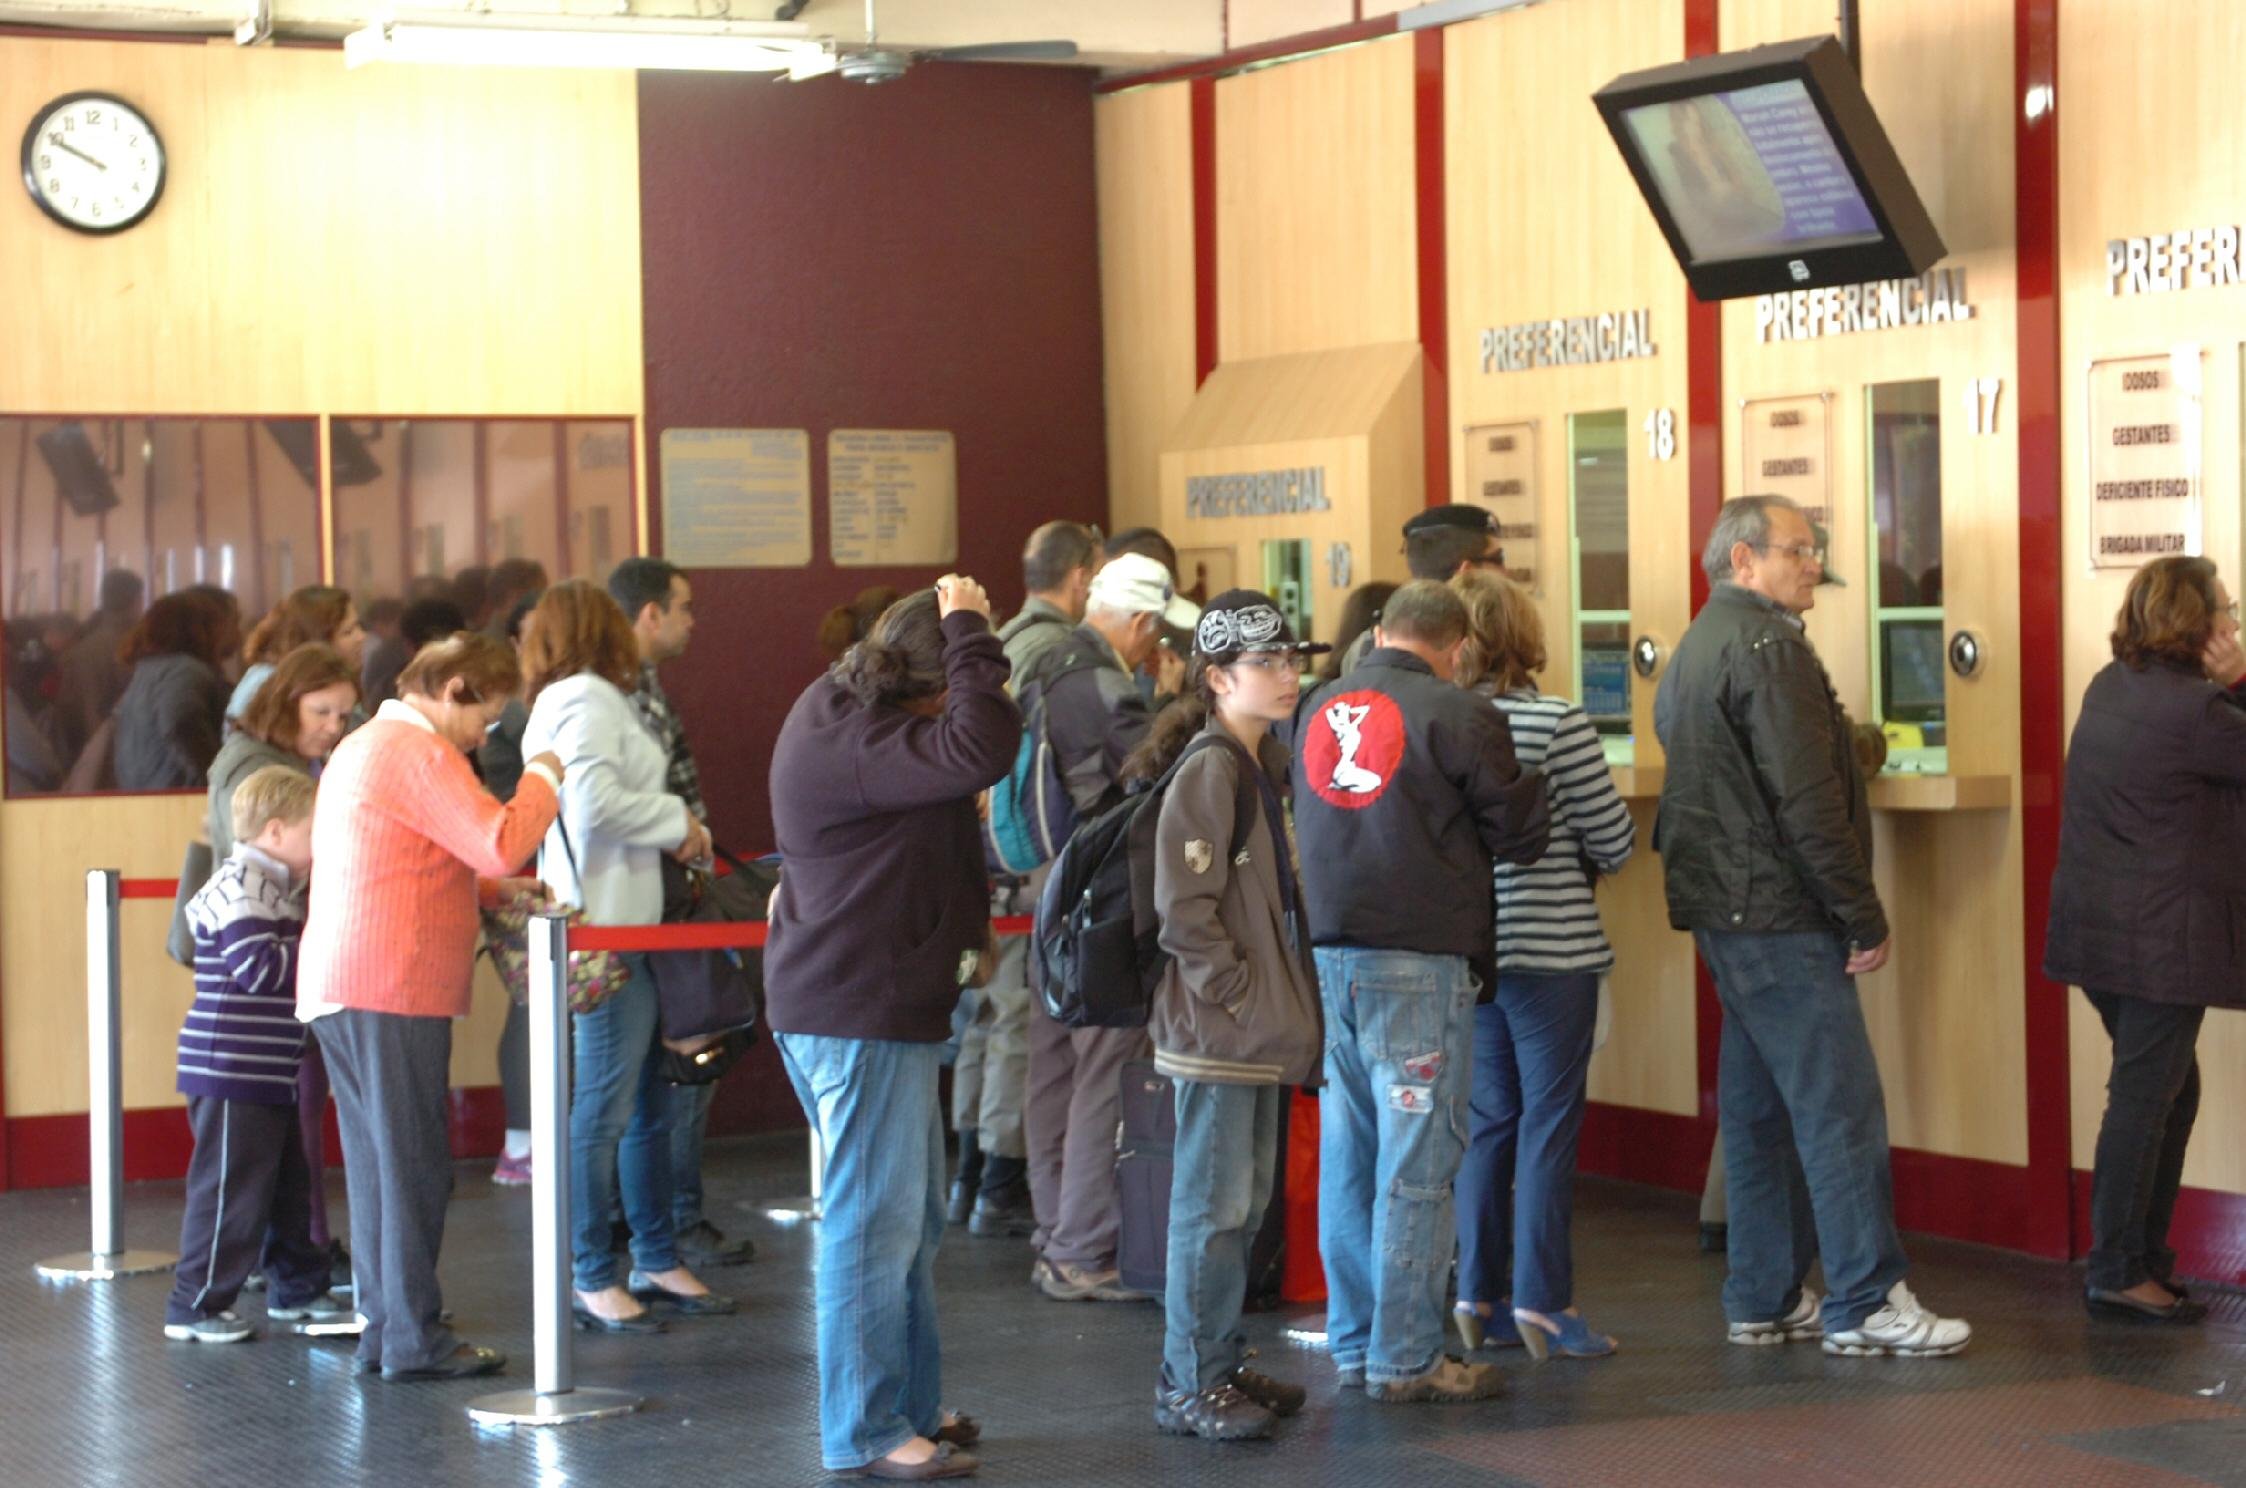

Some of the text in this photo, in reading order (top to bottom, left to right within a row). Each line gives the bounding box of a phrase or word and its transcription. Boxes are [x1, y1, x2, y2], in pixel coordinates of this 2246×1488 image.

[64, 116, 75, 131] 11
[86, 110, 101, 125] 12
[129, 134, 138, 147] 2
[40, 154, 51, 169] 9
[50, 178, 60, 193] 8
[92, 202, 102, 217] 6
[1757, 267, 1974, 342] PREFERENCIAL
[1480, 309, 1654, 373] PREFERENCIAL
[1964, 378, 2002, 434] 17
[1643, 408, 1675, 462] 18
[2112, 424, 2171, 445] GESTANTES
[1186, 466, 1329, 519] PREFERENCIAL
[1326, 542, 1351, 588] 19
